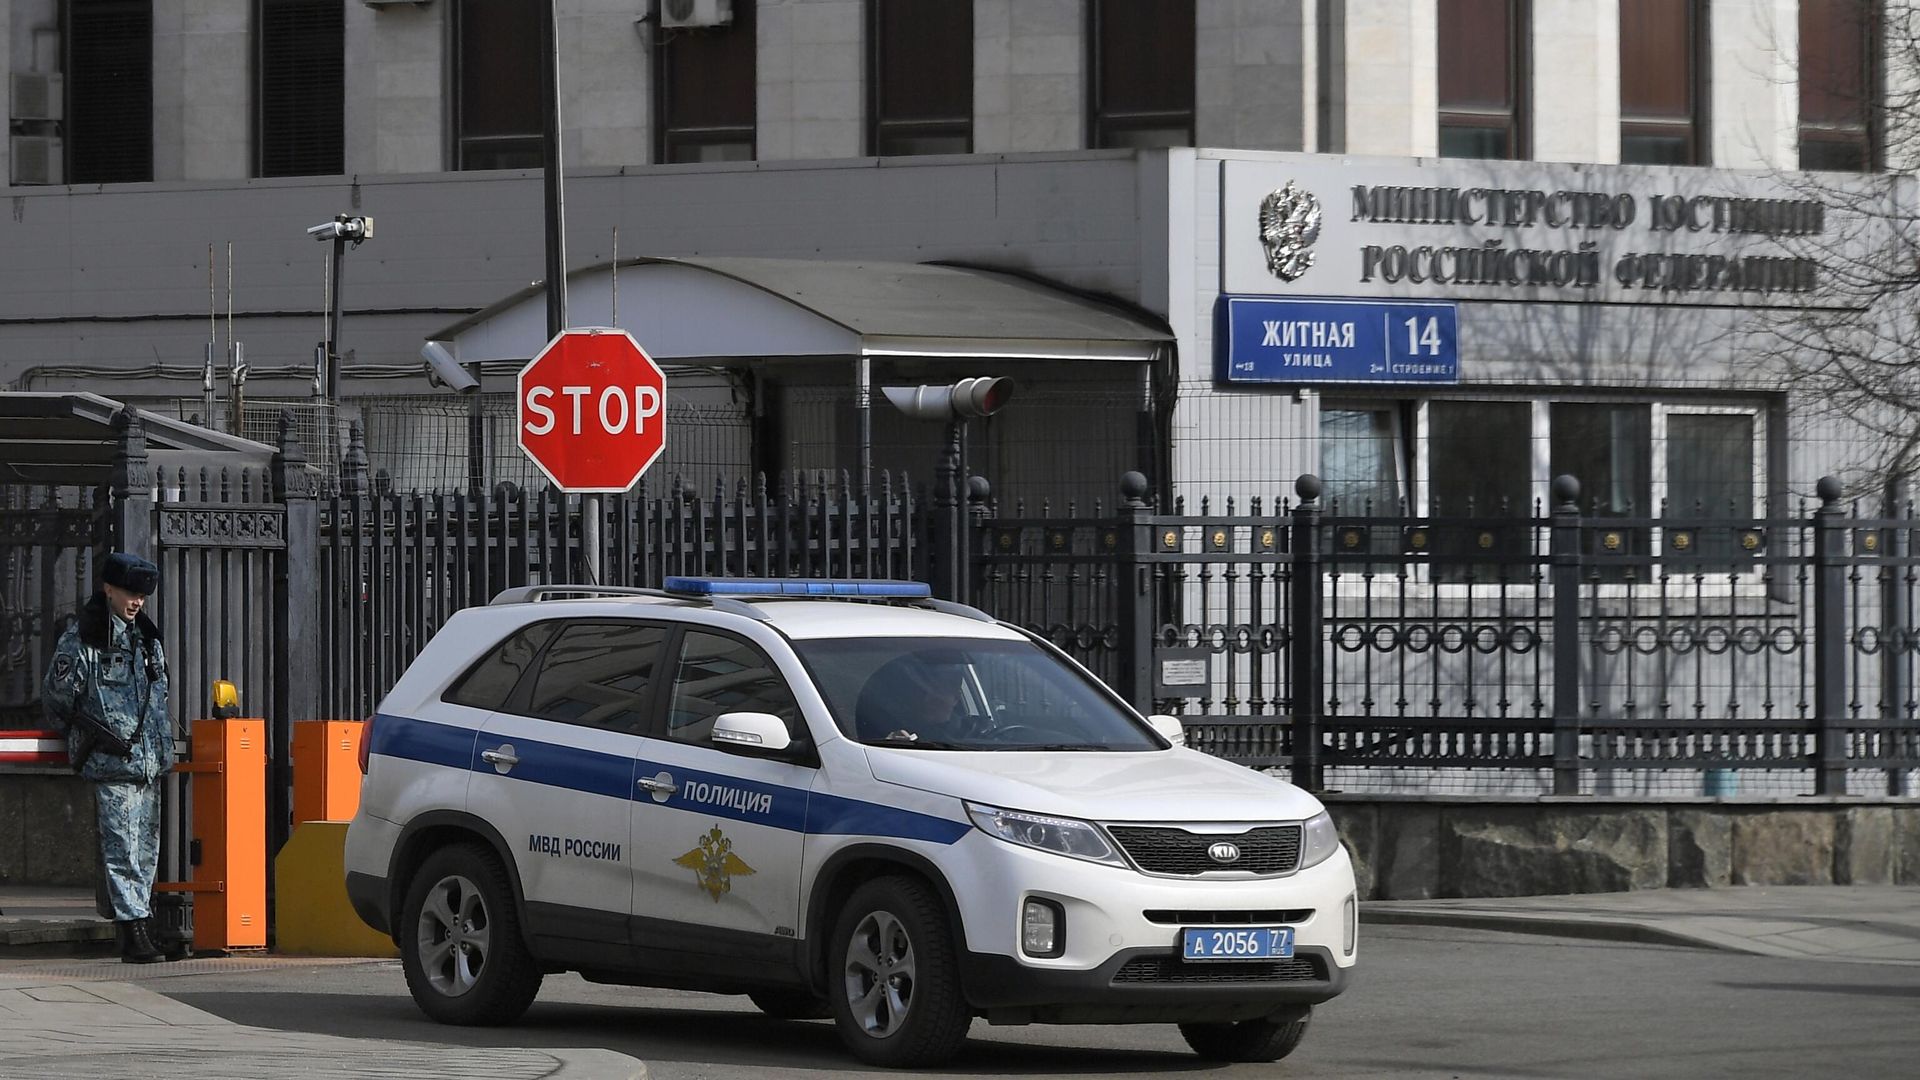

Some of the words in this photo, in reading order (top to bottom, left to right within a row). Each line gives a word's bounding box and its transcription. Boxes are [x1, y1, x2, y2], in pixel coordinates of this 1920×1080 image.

[1350, 185, 1636, 230] МИНИСТЕРСТВО
[1261, 320, 1355, 349] ЖИТНАЯ
[1404, 315, 1442, 357] 14
[1283, 353, 1333, 368] УЛИЦА
[1391, 363, 1447, 375] СТРОЕНИЕ
[524, 385, 661, 436] STOP
[683, 780, 773, 815] ПОЛИЦИЯ
[529, 834, 561, 858] МВД
[564, 838, 621, 862] РОССИИ
[1213, 845, 1237, 858] KIA
[1212, 931, 1259, 955] 2056
[1270, 930, 1288, 948] 77
[1271, 947, 1286, 955] RUS
